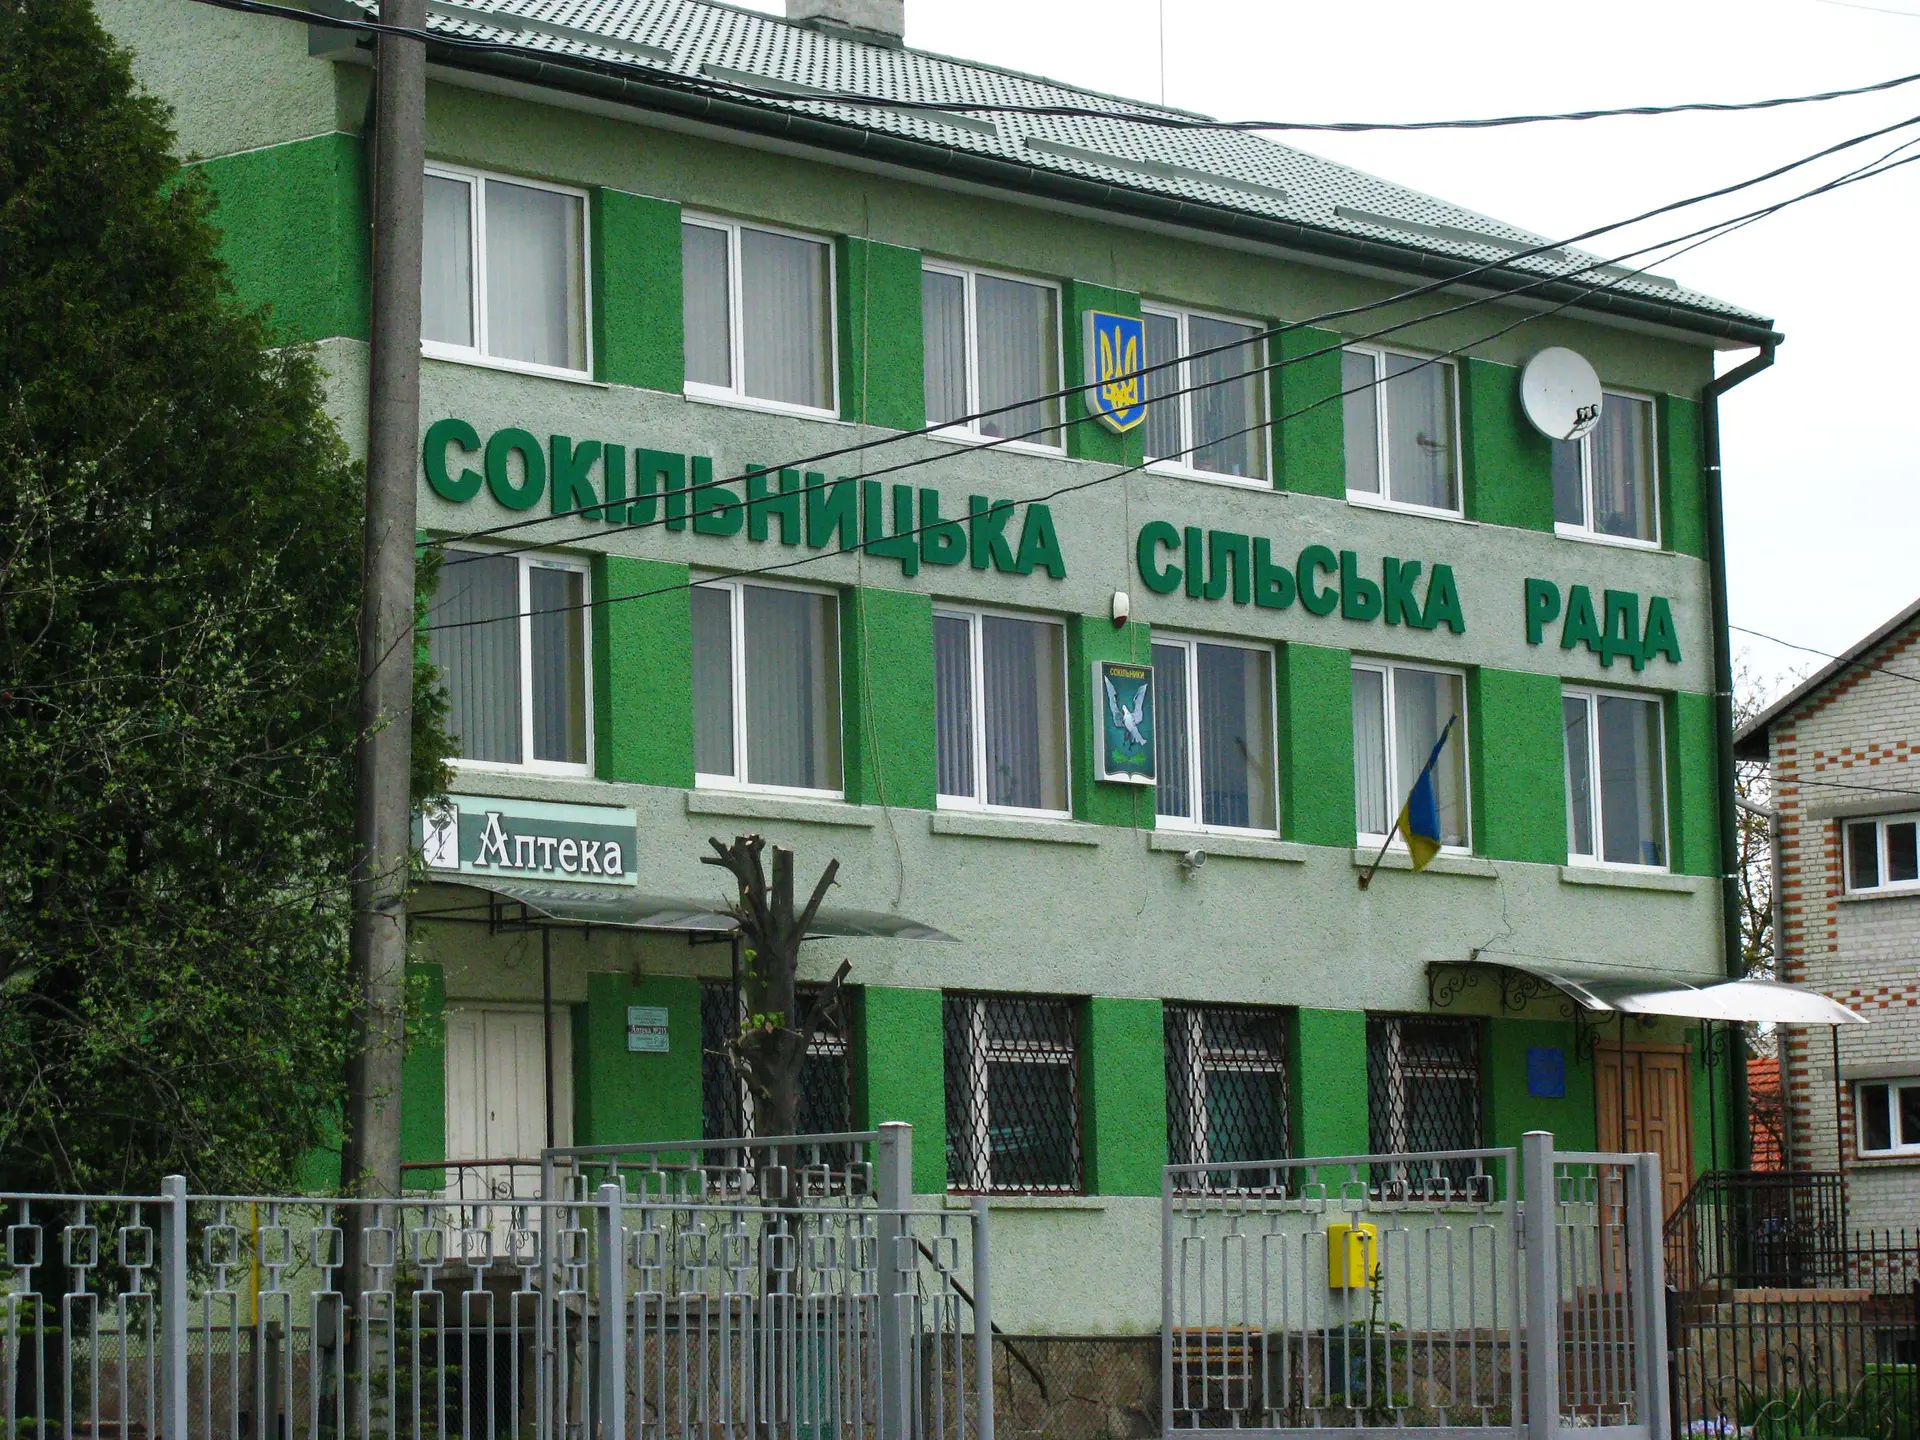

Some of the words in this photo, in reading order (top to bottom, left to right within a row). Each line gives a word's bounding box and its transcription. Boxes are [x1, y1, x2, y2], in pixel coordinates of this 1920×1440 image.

[423, 418, 1066, 578] СОКІЛЬНИЦЬКА
[1137, 521, 1466, 634] СІЛЬСЬКА
[1525, 577, 1682, 672] РАДА
[472, 811, 624, 876] Аптека
